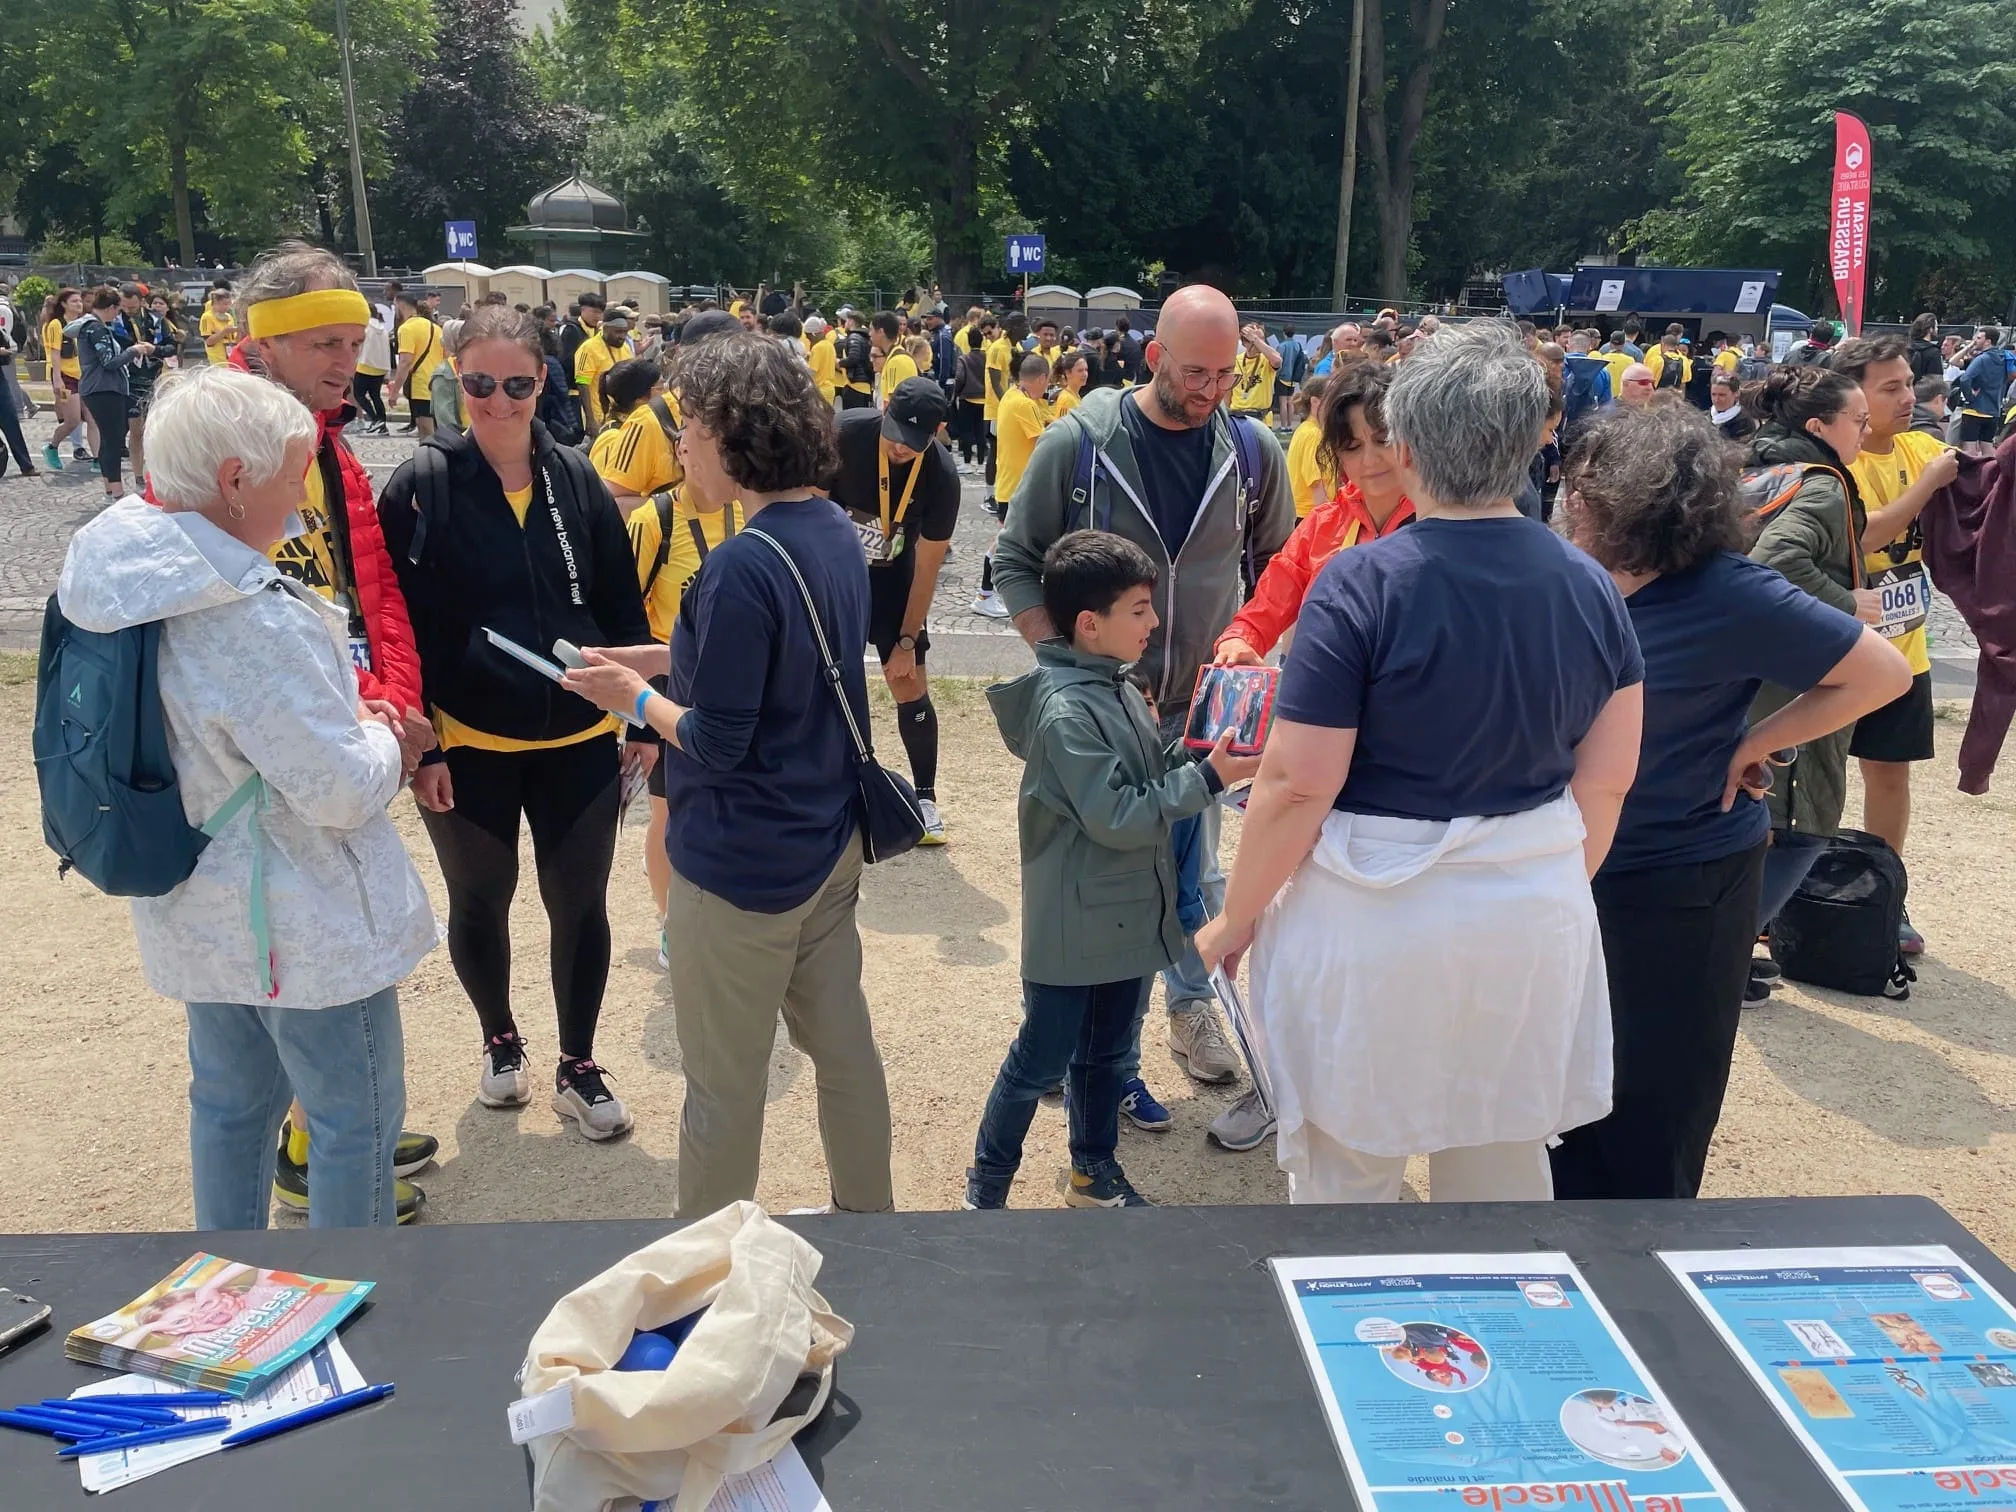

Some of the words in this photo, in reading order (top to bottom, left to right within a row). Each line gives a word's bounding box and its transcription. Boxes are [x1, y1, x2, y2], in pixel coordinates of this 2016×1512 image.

[458, 232, 474, 248] WC
[1022, 246, 1042, 262] WC
[549, 507, 564, 531] new
[557, 531, 578, 580] balance
[1882, 583, 1916, 612] 068
[1885, 607, 1916, 622] GONZALES
[180, 1289, 294, 1357] Muscles
[236, 1329, 260, 1347] TOUT
[1407, 1476, 1455, 1485] maladie
[1459, 1475, 1469, 1484] la
